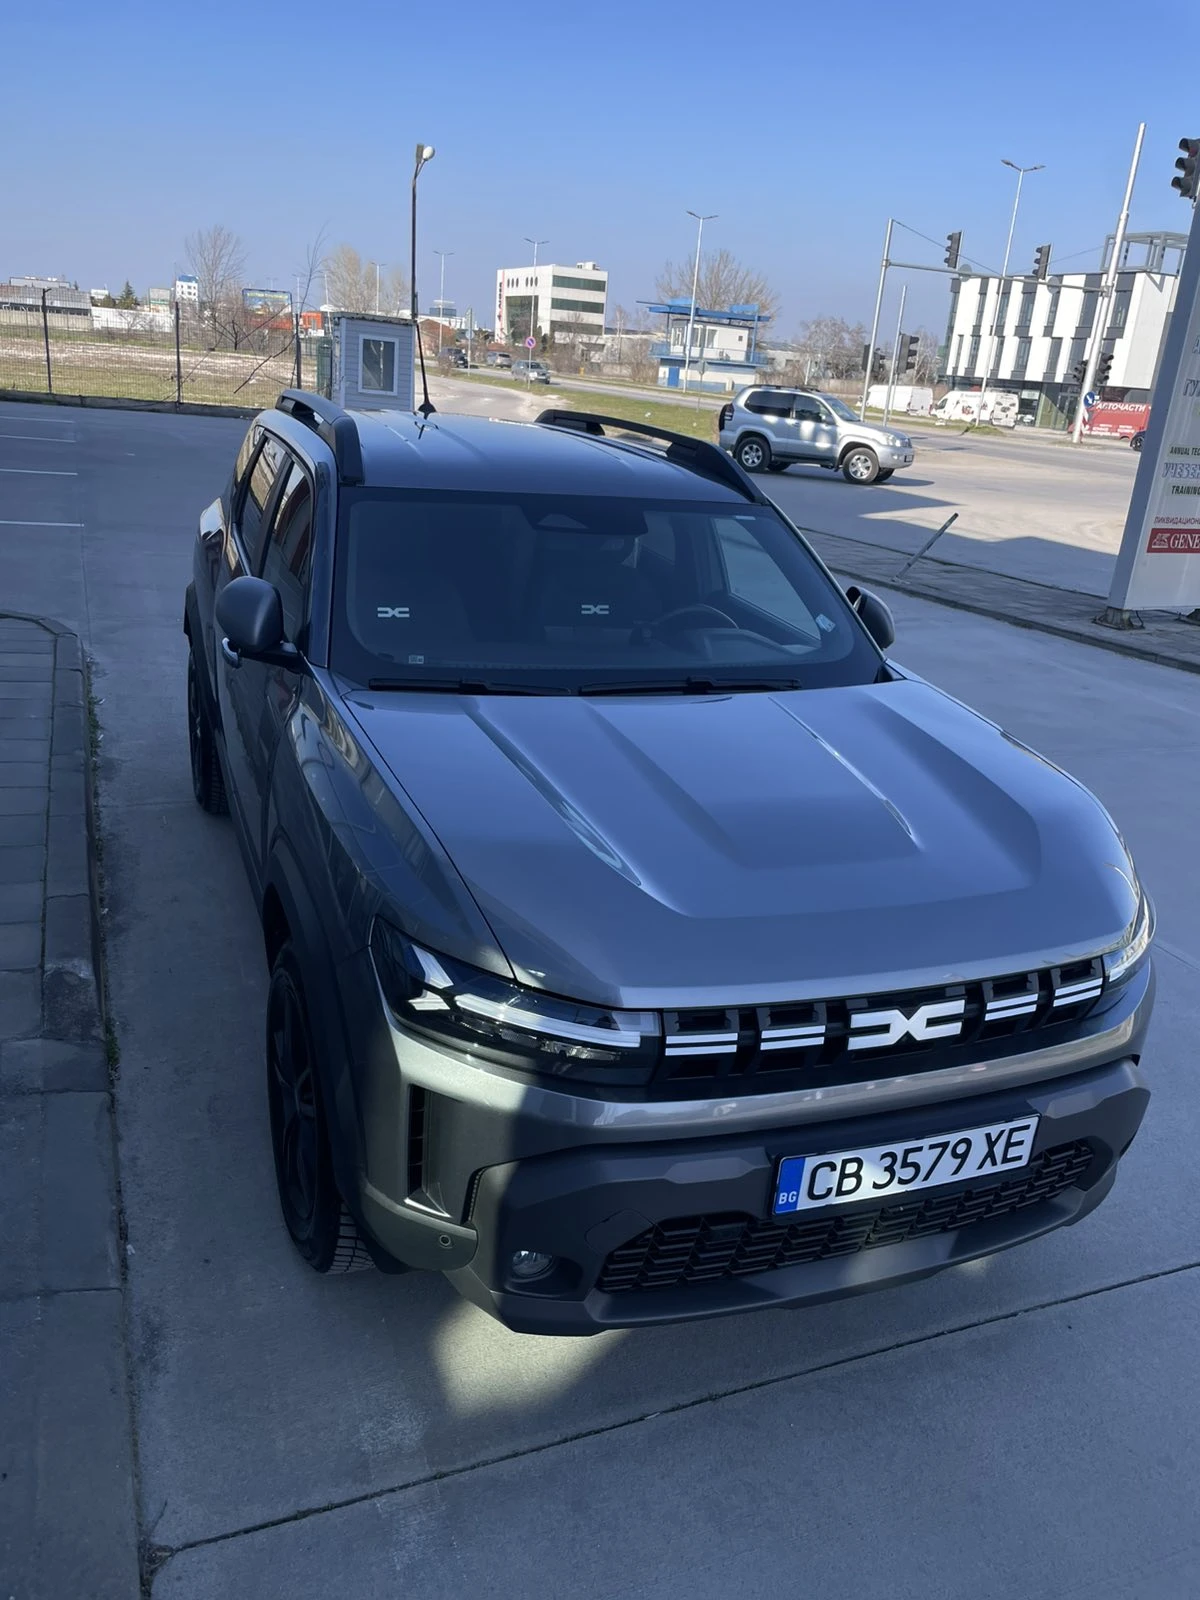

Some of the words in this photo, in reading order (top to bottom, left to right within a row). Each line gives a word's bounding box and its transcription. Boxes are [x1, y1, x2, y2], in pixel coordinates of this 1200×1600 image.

[1183, 378, 1200, 397] ГУ
[807, 1156, 864, 1201] CB
[872, 1137, 973, 1191] 3579
[976, 1124, 1031, 1171] XE
[778, 1191, 797, 1204] BG
